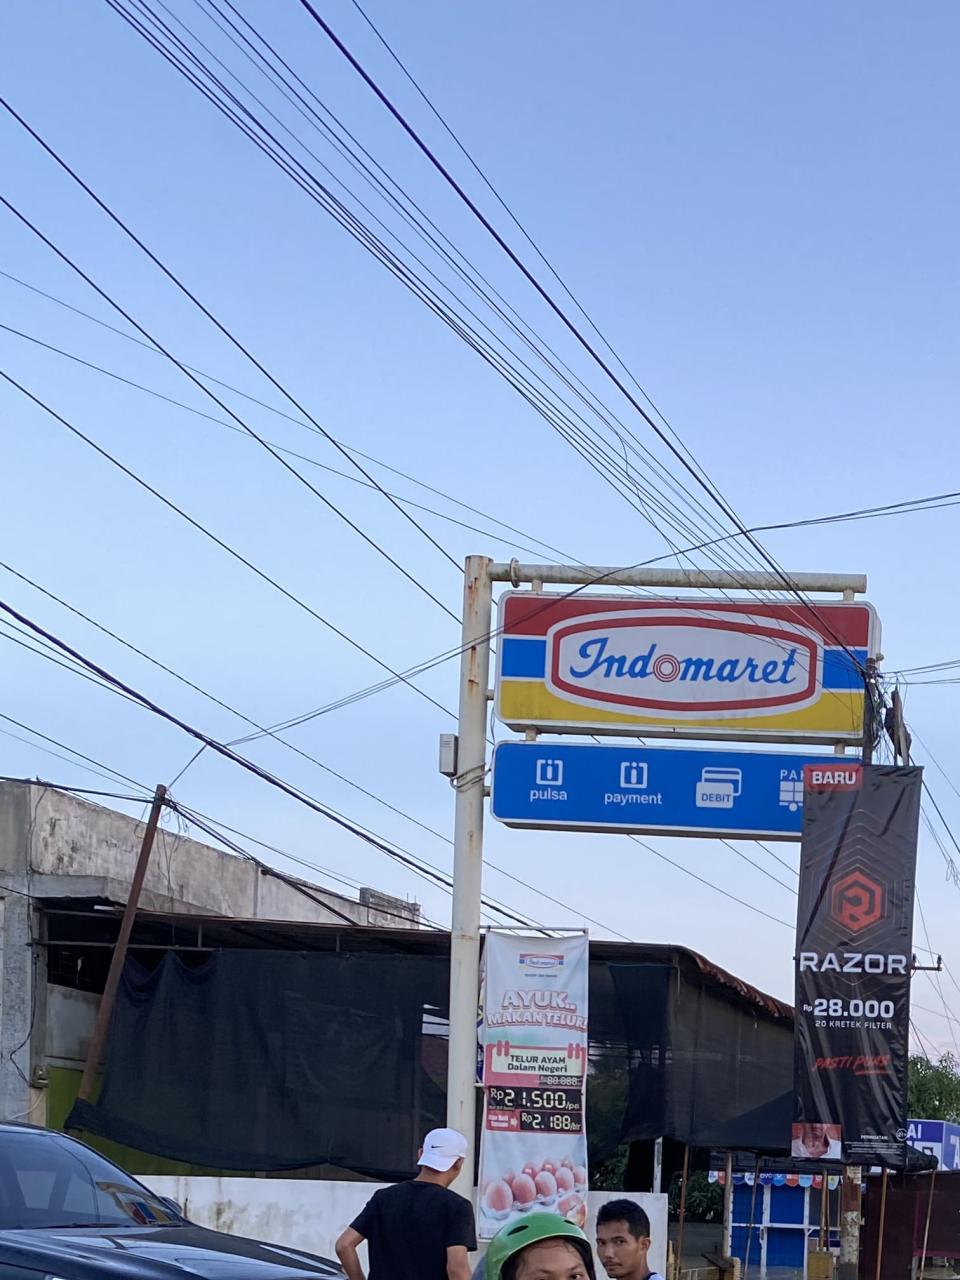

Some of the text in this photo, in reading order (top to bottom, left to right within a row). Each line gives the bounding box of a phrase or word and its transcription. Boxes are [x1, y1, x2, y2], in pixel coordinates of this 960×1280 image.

[569, 637, 796, 685] Indomaret
[812, 770, 857, 785] BARU
[529, 788, 568, 801] pulsa
[604, 790, 662, 808] payment
[701, 793, 732, 804] DEBIT
[799, 952, 907, 975] RAZOR
[487, 1011, 543, 1027] MAKAN
[815, 1020, 892, 1029] 20 KRETEK FILTER
[511, 1055, 566, 1064] TELUR AYAM
[507, 1063, 568, 1073] Dalam Negeri
